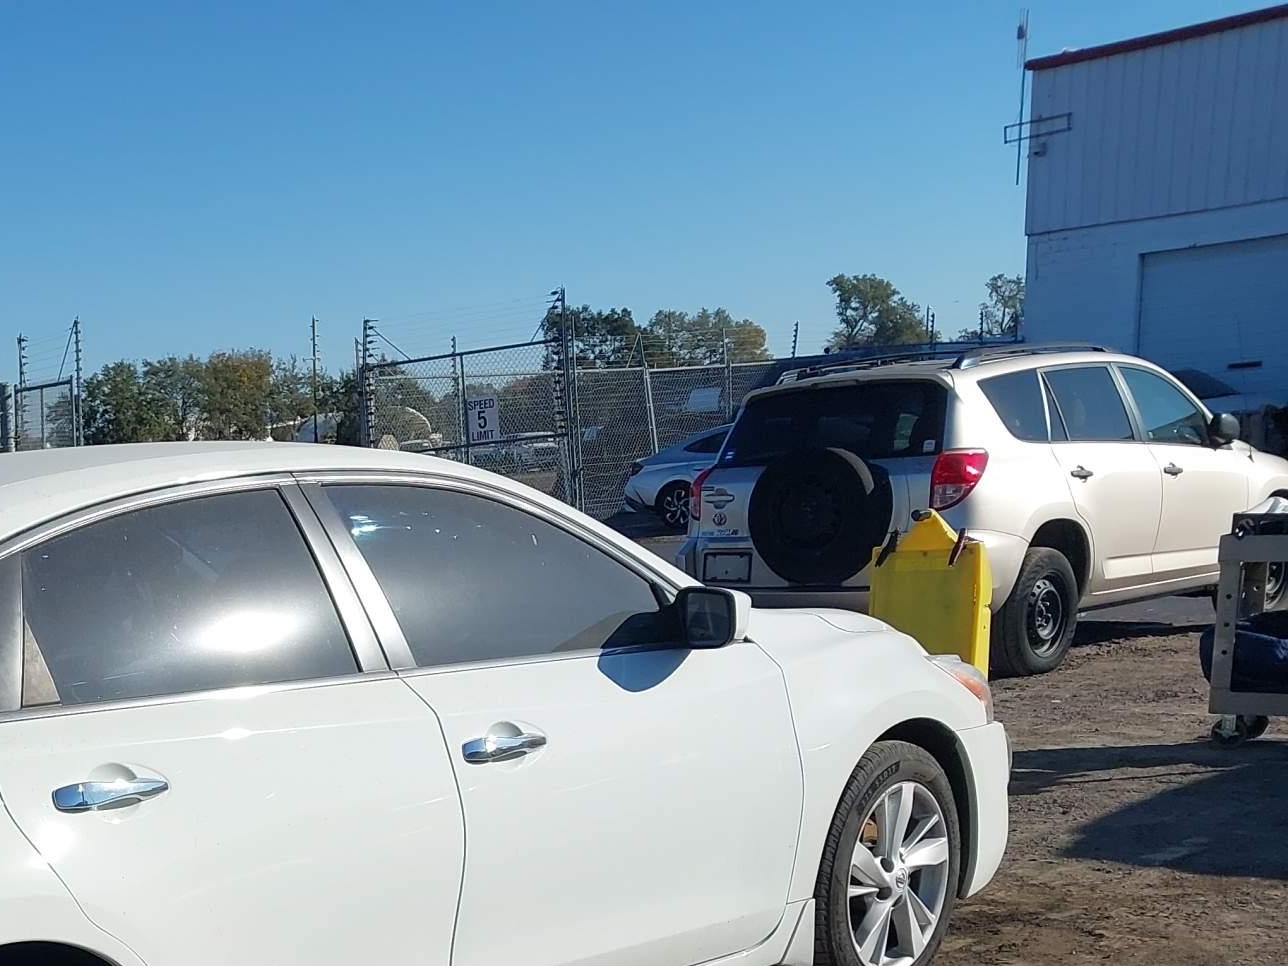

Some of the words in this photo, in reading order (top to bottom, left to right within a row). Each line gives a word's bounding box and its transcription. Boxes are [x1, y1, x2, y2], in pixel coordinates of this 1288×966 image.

[467, 398, 495, 411] SPEED
[477, 410, 488, 430] 5
[472, 429, 495, 441] LIMIT
